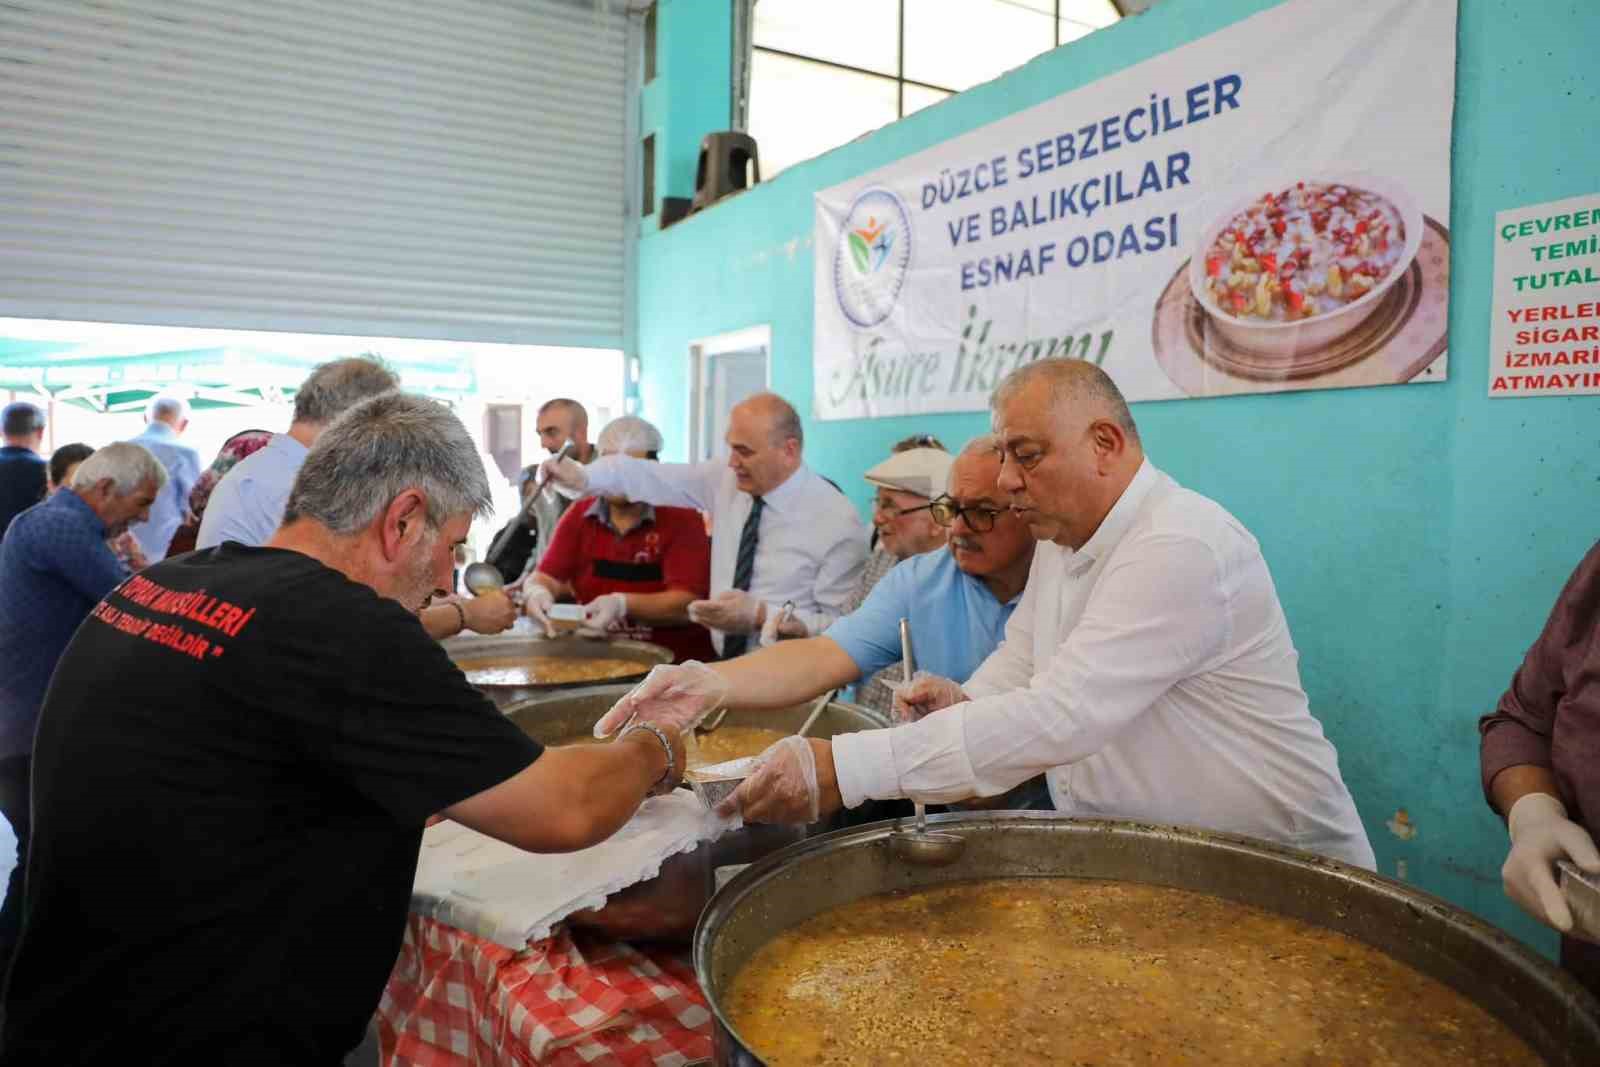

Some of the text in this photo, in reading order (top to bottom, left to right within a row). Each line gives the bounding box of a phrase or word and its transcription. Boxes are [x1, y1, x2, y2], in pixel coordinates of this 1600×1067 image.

[921, 73, 1242, 211] DÜZCE SEBZECİLER
[947, 151, 1191, 247] VE BALIKÇILAR
[960, 212, 1178, 292] ESNAF ODASI
[1531, 234, 1600, 262] TEMİ
[1507, 302, 1600, 324] YERLE
